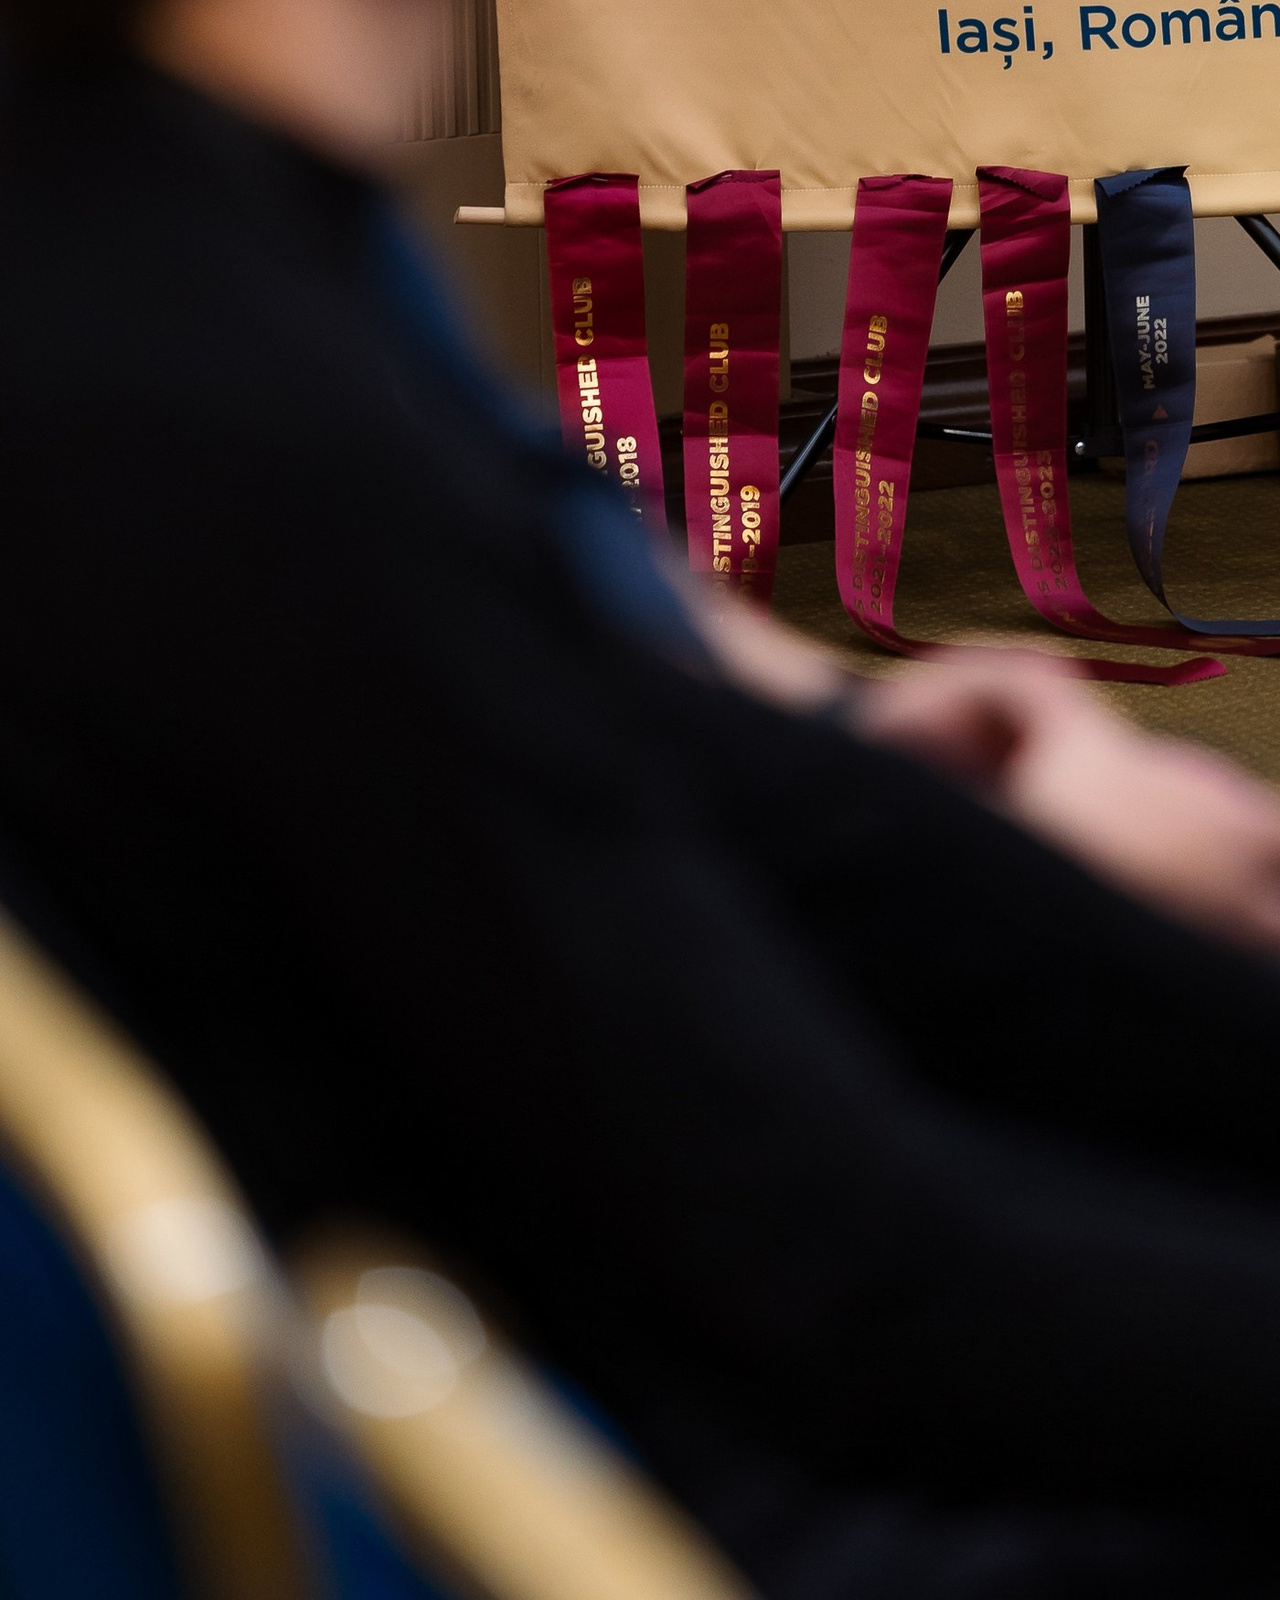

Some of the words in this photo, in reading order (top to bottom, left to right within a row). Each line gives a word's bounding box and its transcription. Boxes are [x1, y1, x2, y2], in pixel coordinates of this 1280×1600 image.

[937, 5, 1054, 70] Iași,
[572, 277, 595, 346] CLUB
[1005, 290, 1025, 361] CLUB
[1136, 294, 1156, 390] MAY-JUNE
[1154, 317, 1168, 364] 2022
[709, 322, 731, 393] CLUB
[863, 314, 888, 385] CLUB
[574, 354, 608, 476] GUISHED
[852, 390, 879, 591] DISTINGUISHED
[1009, 370, 1045, 572] DISTINGUISHED
